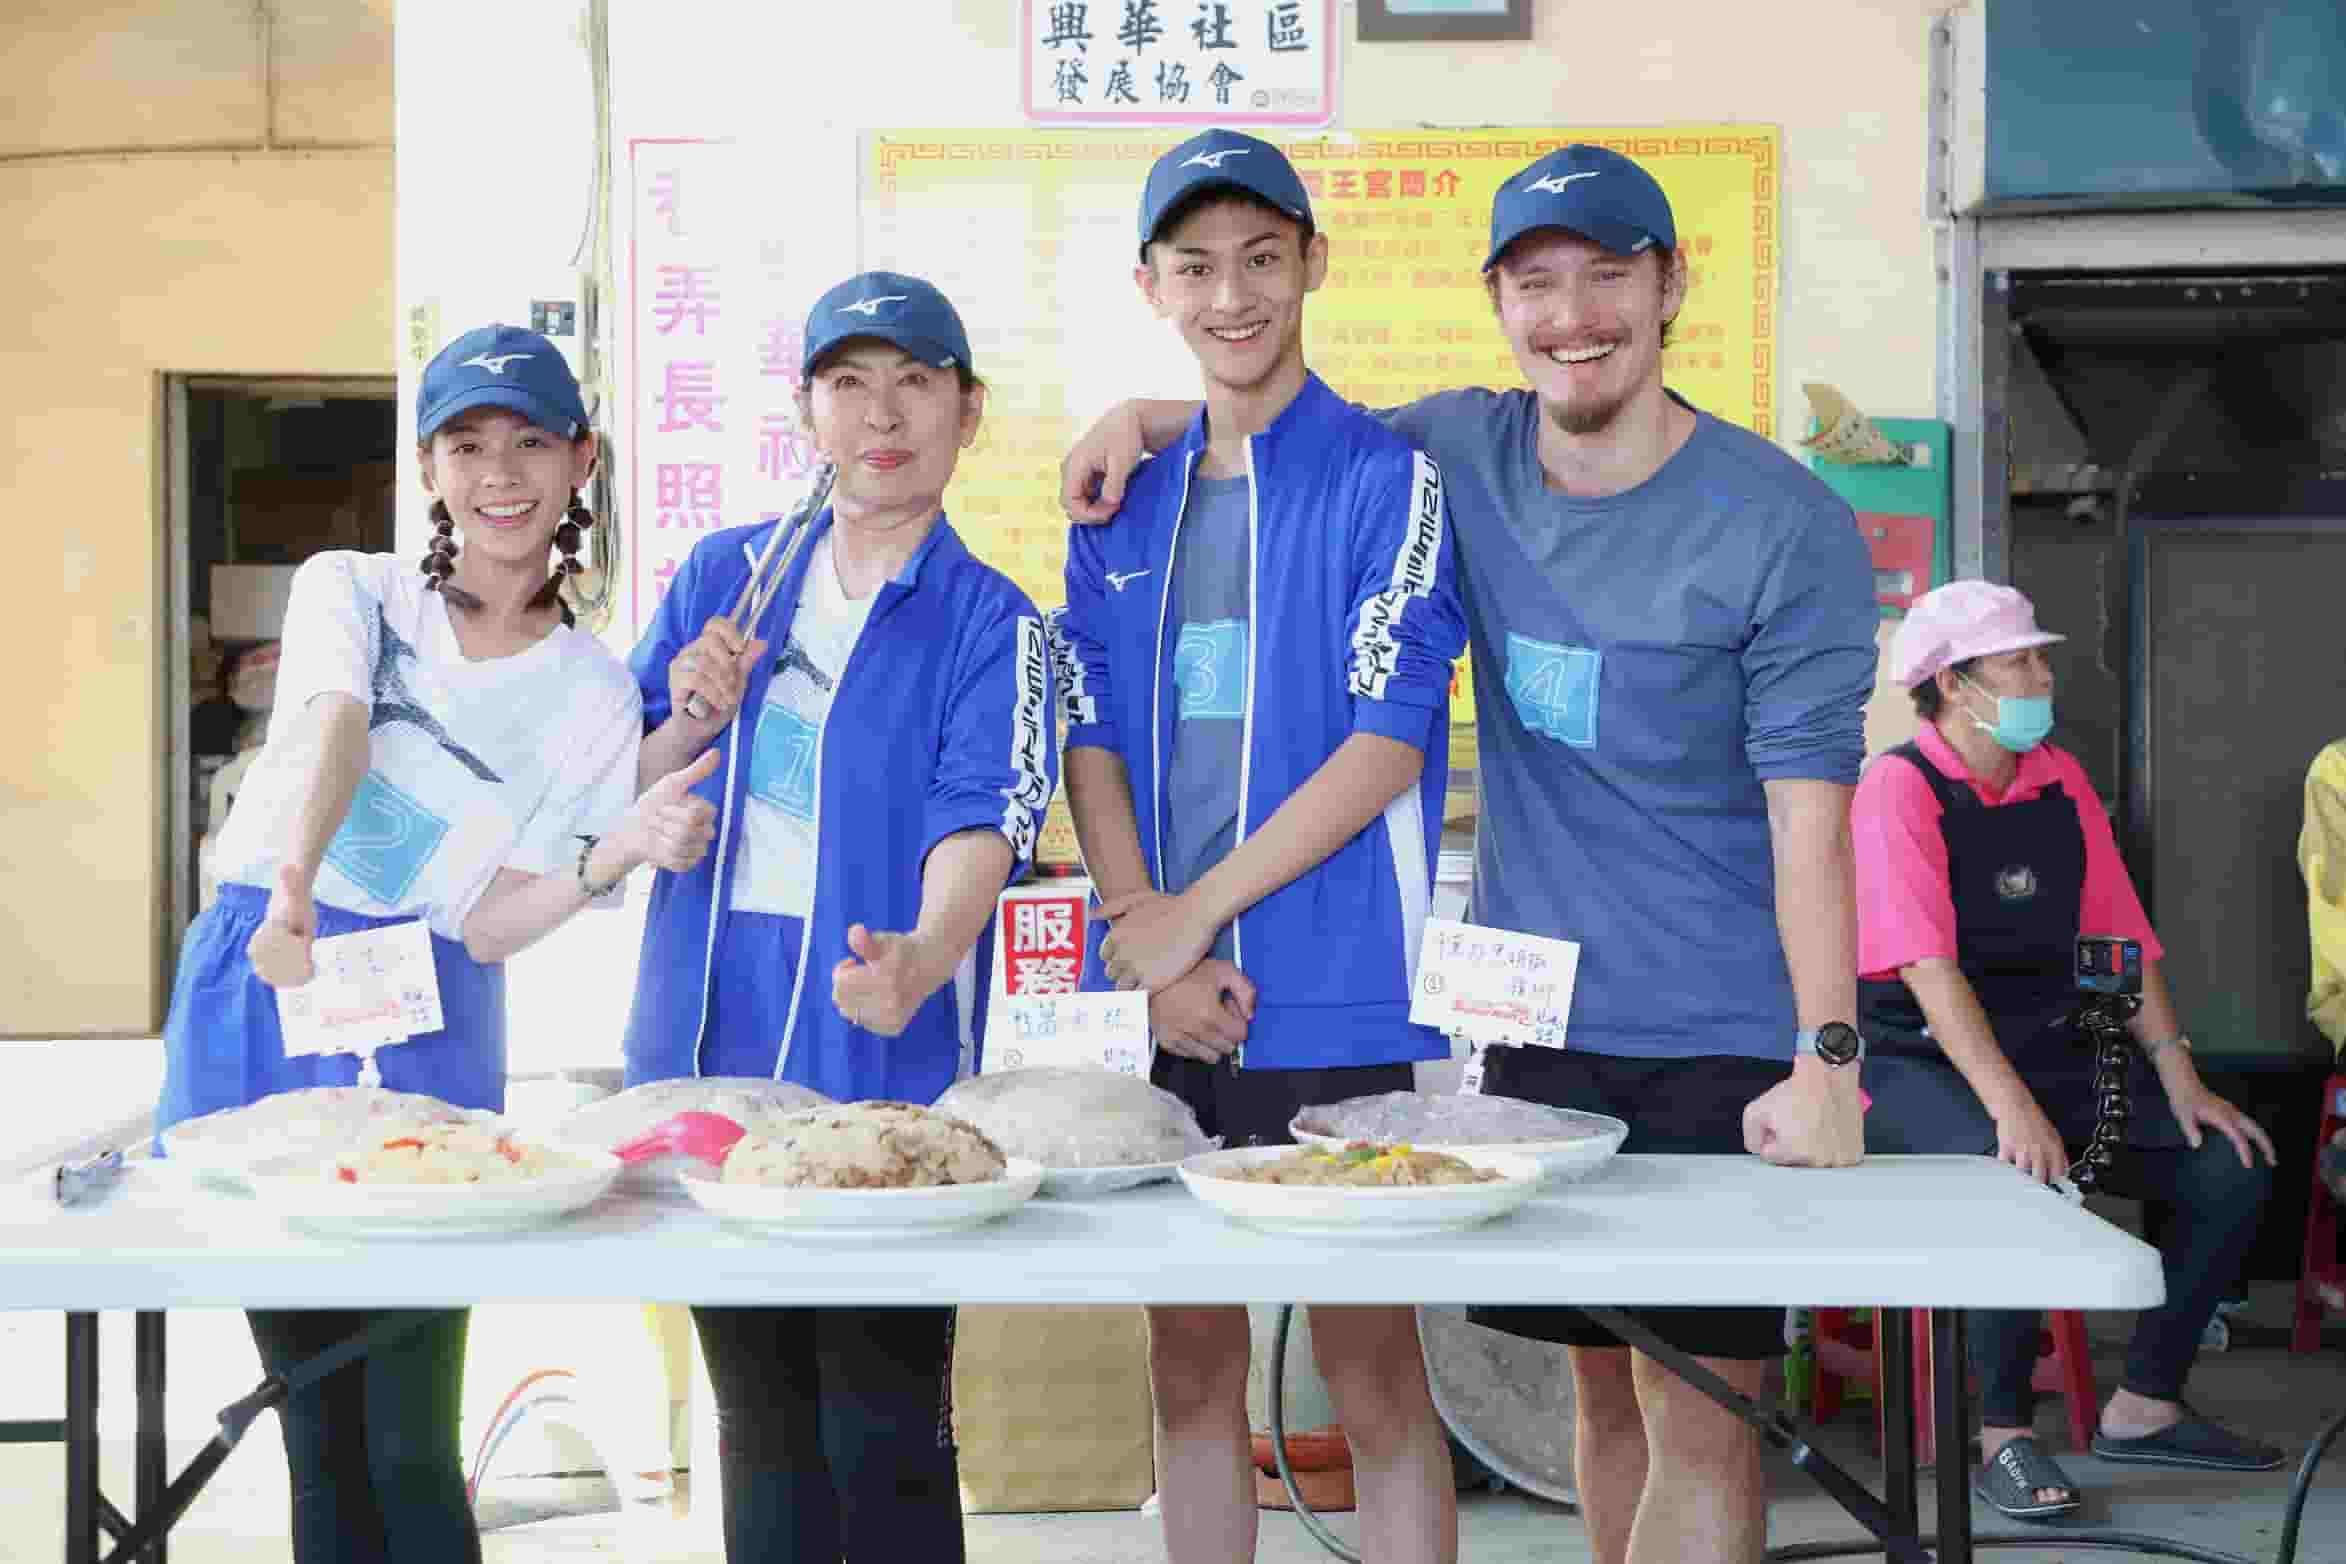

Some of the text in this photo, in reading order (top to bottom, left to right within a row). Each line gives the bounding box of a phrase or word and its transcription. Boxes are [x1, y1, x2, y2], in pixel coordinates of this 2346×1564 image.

[1041, 0, 1310, 55] 興華社區
[1053, 58, 1245, 104] 發展協會
[1181, 635, 1217, 706] 3
[1519, 657, 1568, 730] 4
[338, 788, 410, 881] 2
